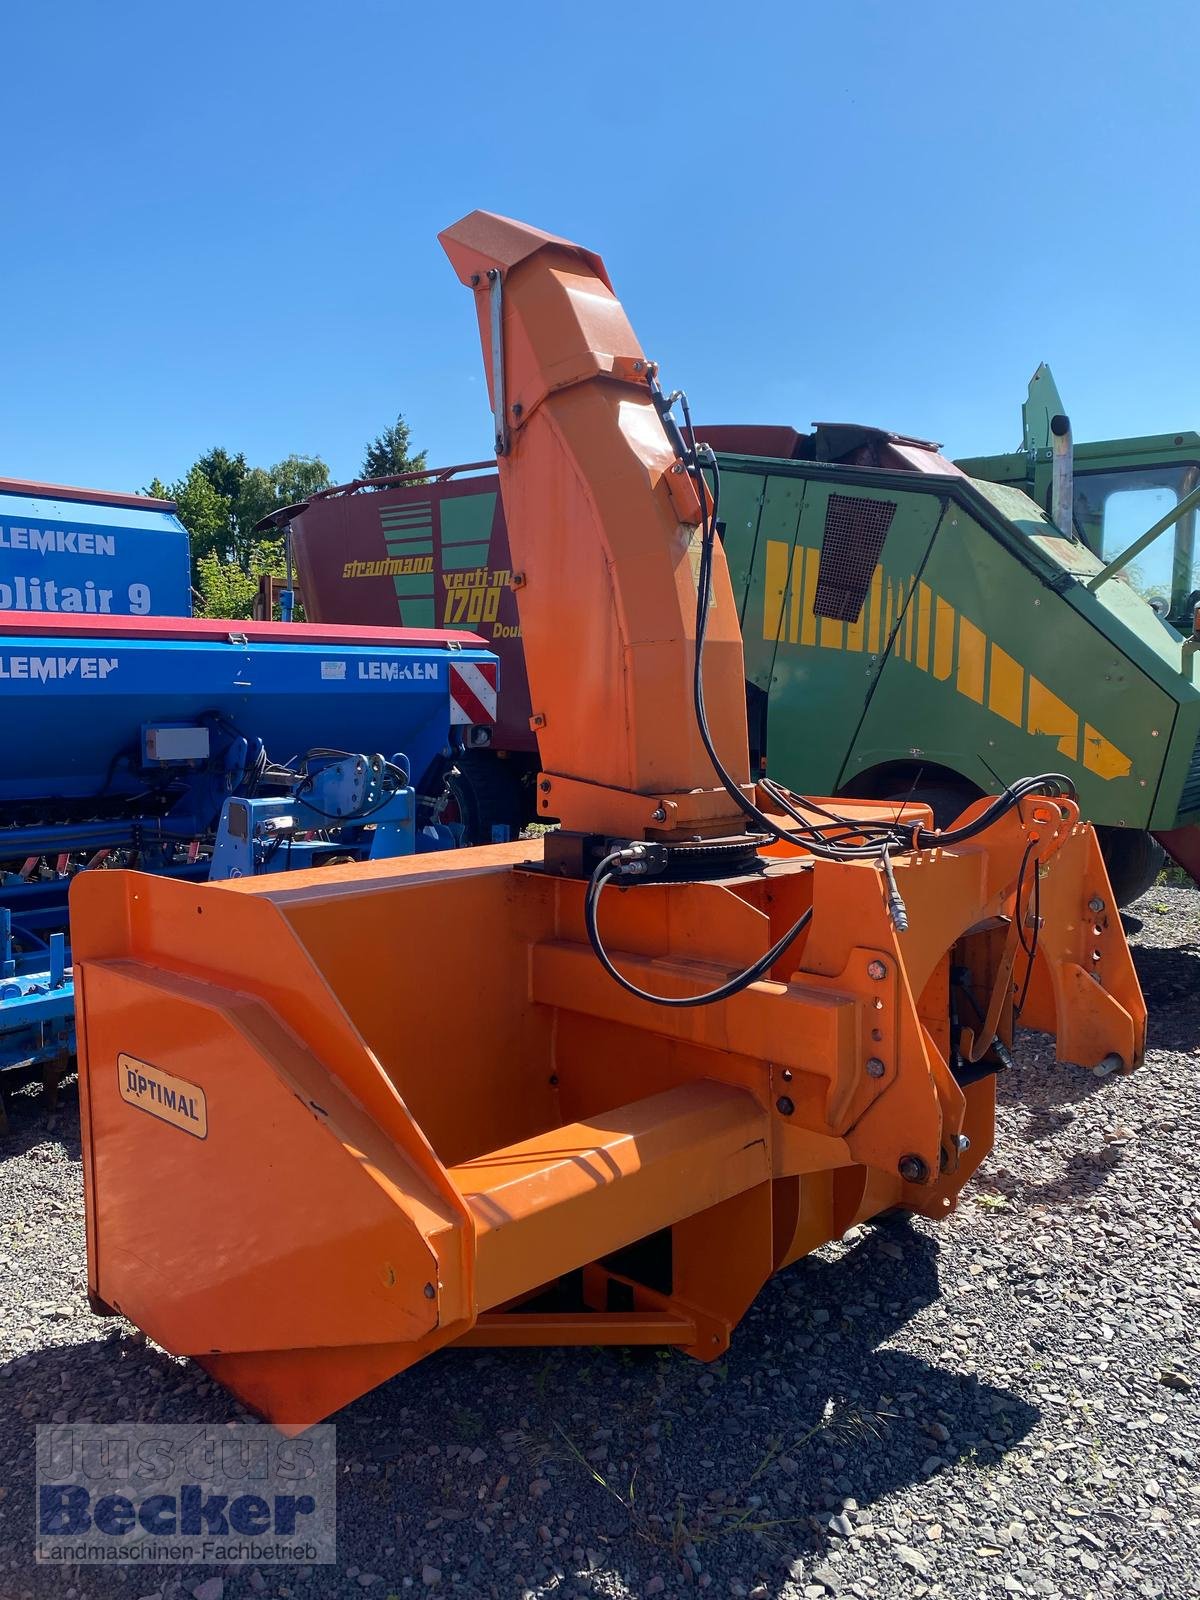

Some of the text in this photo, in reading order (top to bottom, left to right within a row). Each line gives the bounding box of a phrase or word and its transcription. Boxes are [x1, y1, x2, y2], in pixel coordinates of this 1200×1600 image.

[0, 526, 115, 556] LEMKEN
[342, 557, 434, 579] strautmann
[128, 583, 151, 615] 9
[443, 587, 501, 624] 1700
[127, 1069, 199, 1121] OPTIMAL
